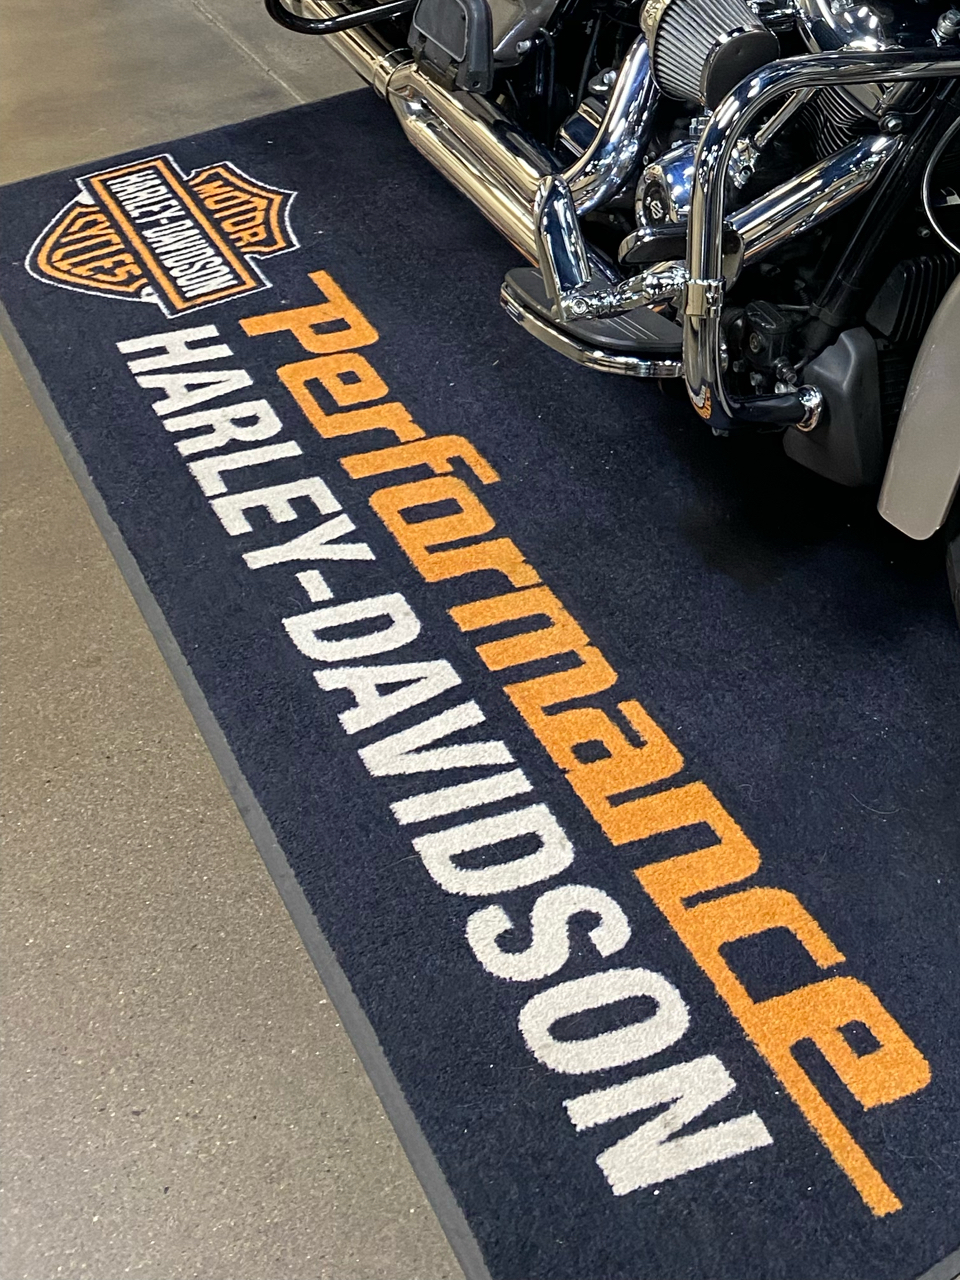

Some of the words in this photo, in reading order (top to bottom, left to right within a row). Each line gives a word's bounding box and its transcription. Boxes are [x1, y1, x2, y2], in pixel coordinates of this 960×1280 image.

[51, 211, 143, 284] CYCLES
[106, 169, 238, 299] HARLEY-DAVIDSON
[189, 180, 270, 253] MOTOR
[115, 324, 774, 1198] HARLEY-DAVIDSON
[240, 269, 932, 1218] Performance
